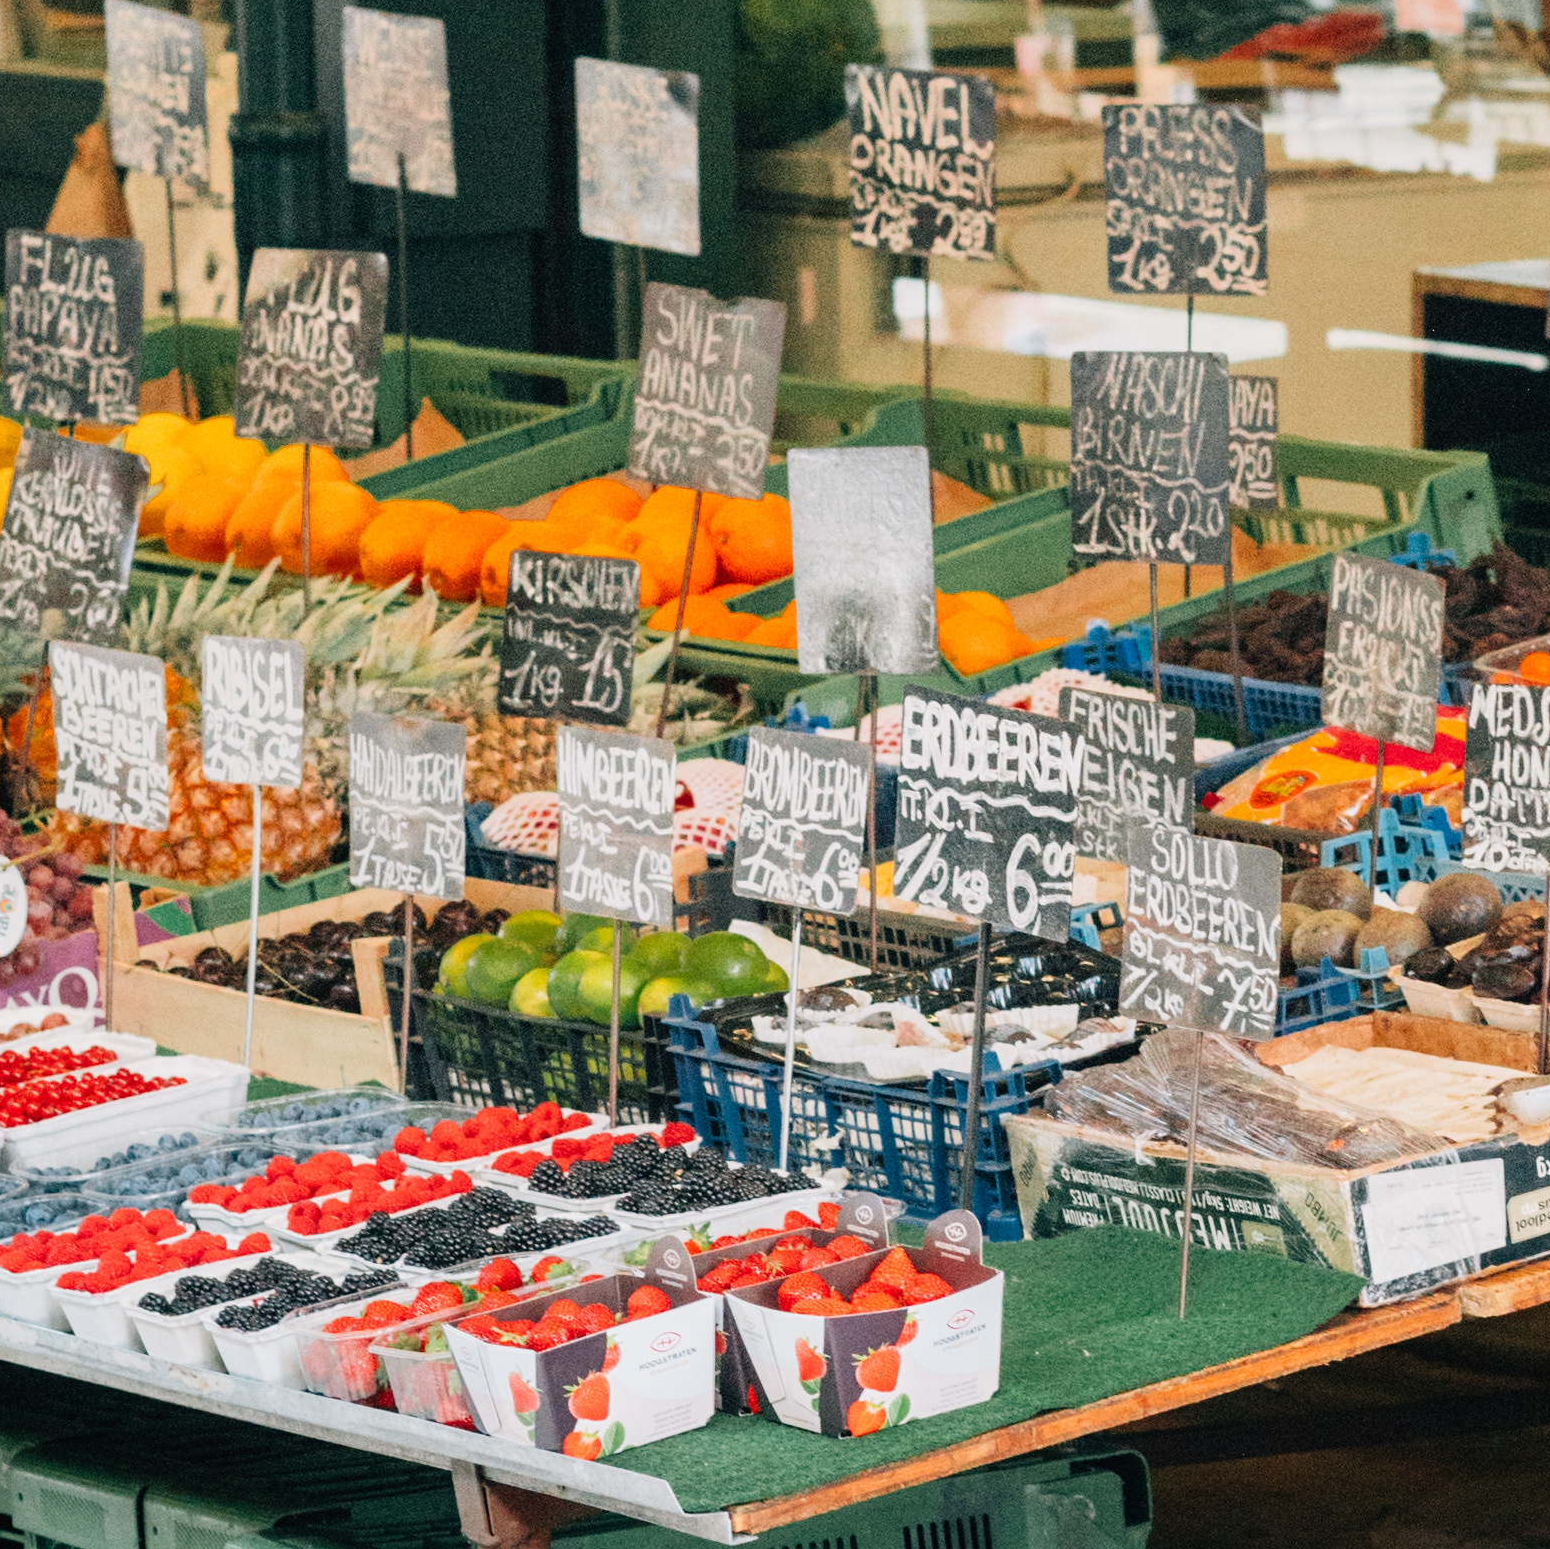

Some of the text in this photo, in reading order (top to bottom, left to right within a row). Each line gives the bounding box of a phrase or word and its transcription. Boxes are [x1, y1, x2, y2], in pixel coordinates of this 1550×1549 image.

[641, 347, 753, 428] ANANAS
[204, 637, 305, 722] RIBISEL
[61, 699, 158, 761] BEEREN
[901, 694, 1087, 796] ERDBEEREN
[1068, 689, 1177, 764] FRISCHE
[558, 729, 678, 815] HIMBEEREN
[1128, 864, 1281, 963] ERDBEEREN
